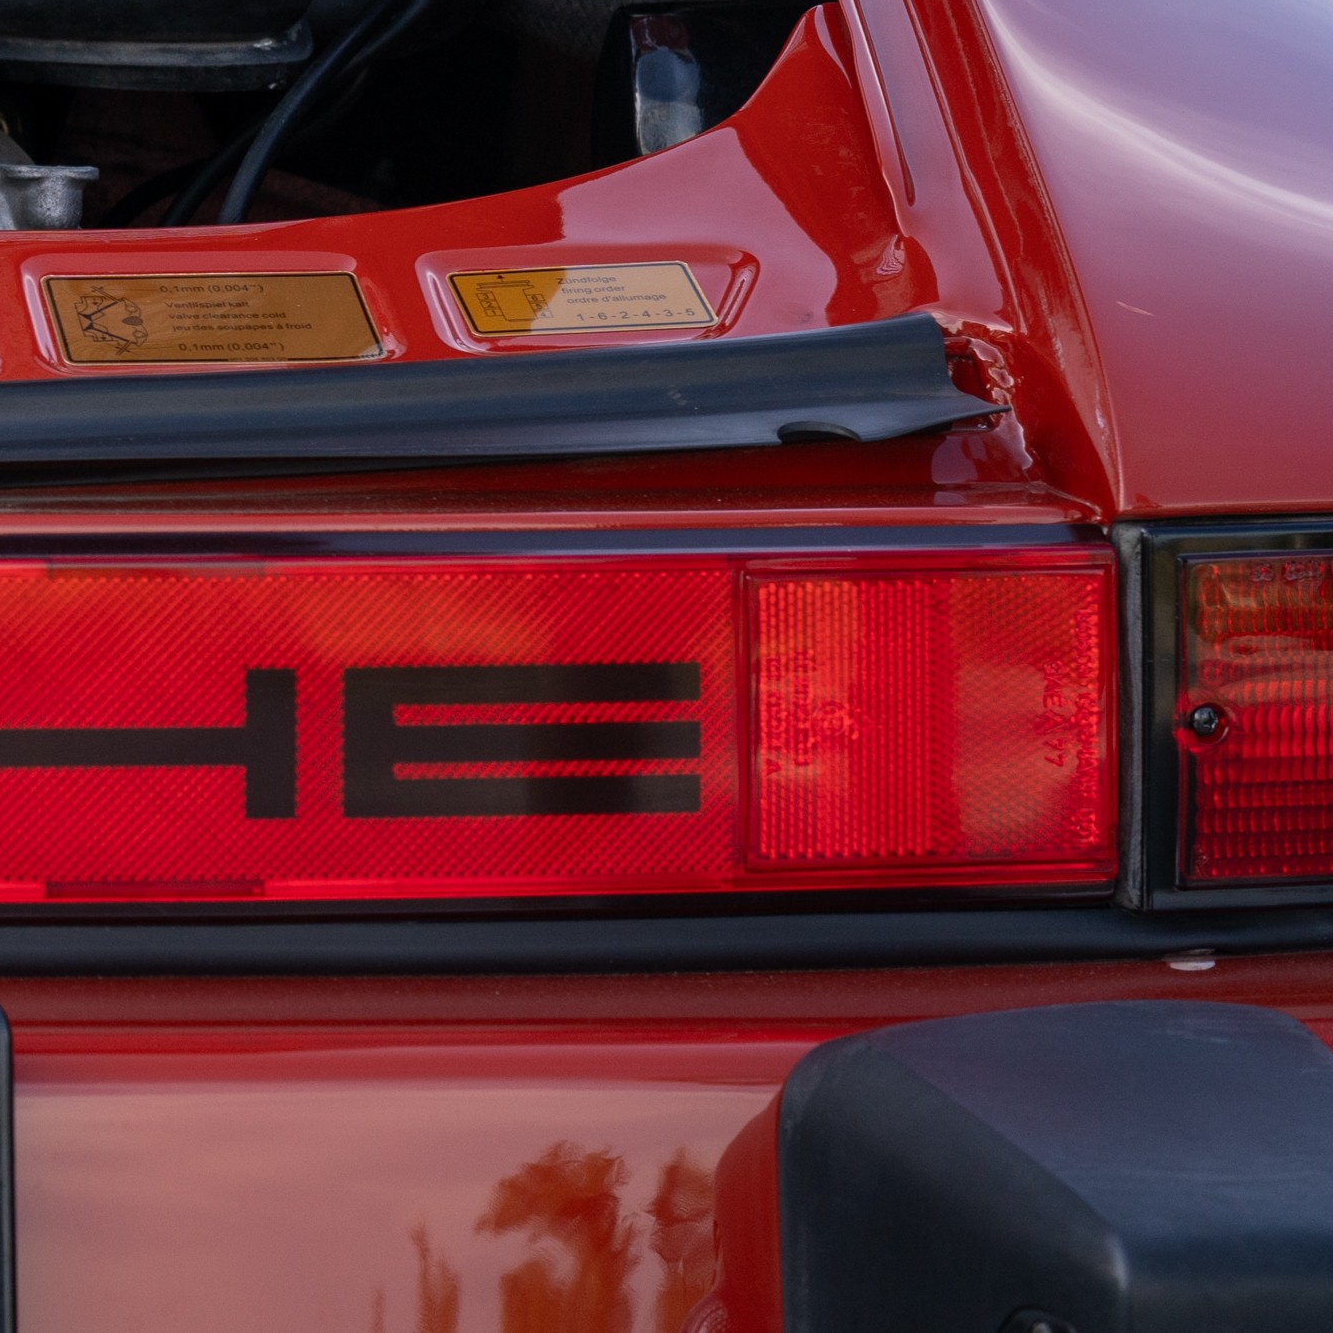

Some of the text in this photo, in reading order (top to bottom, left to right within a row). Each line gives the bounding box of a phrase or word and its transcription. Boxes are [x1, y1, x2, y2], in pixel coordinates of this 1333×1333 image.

[554, 275, 618, 285] Zündfolge
[559, 284, 627, 295] firing order
[565, 293, 668, 304] ordre d'allumage
